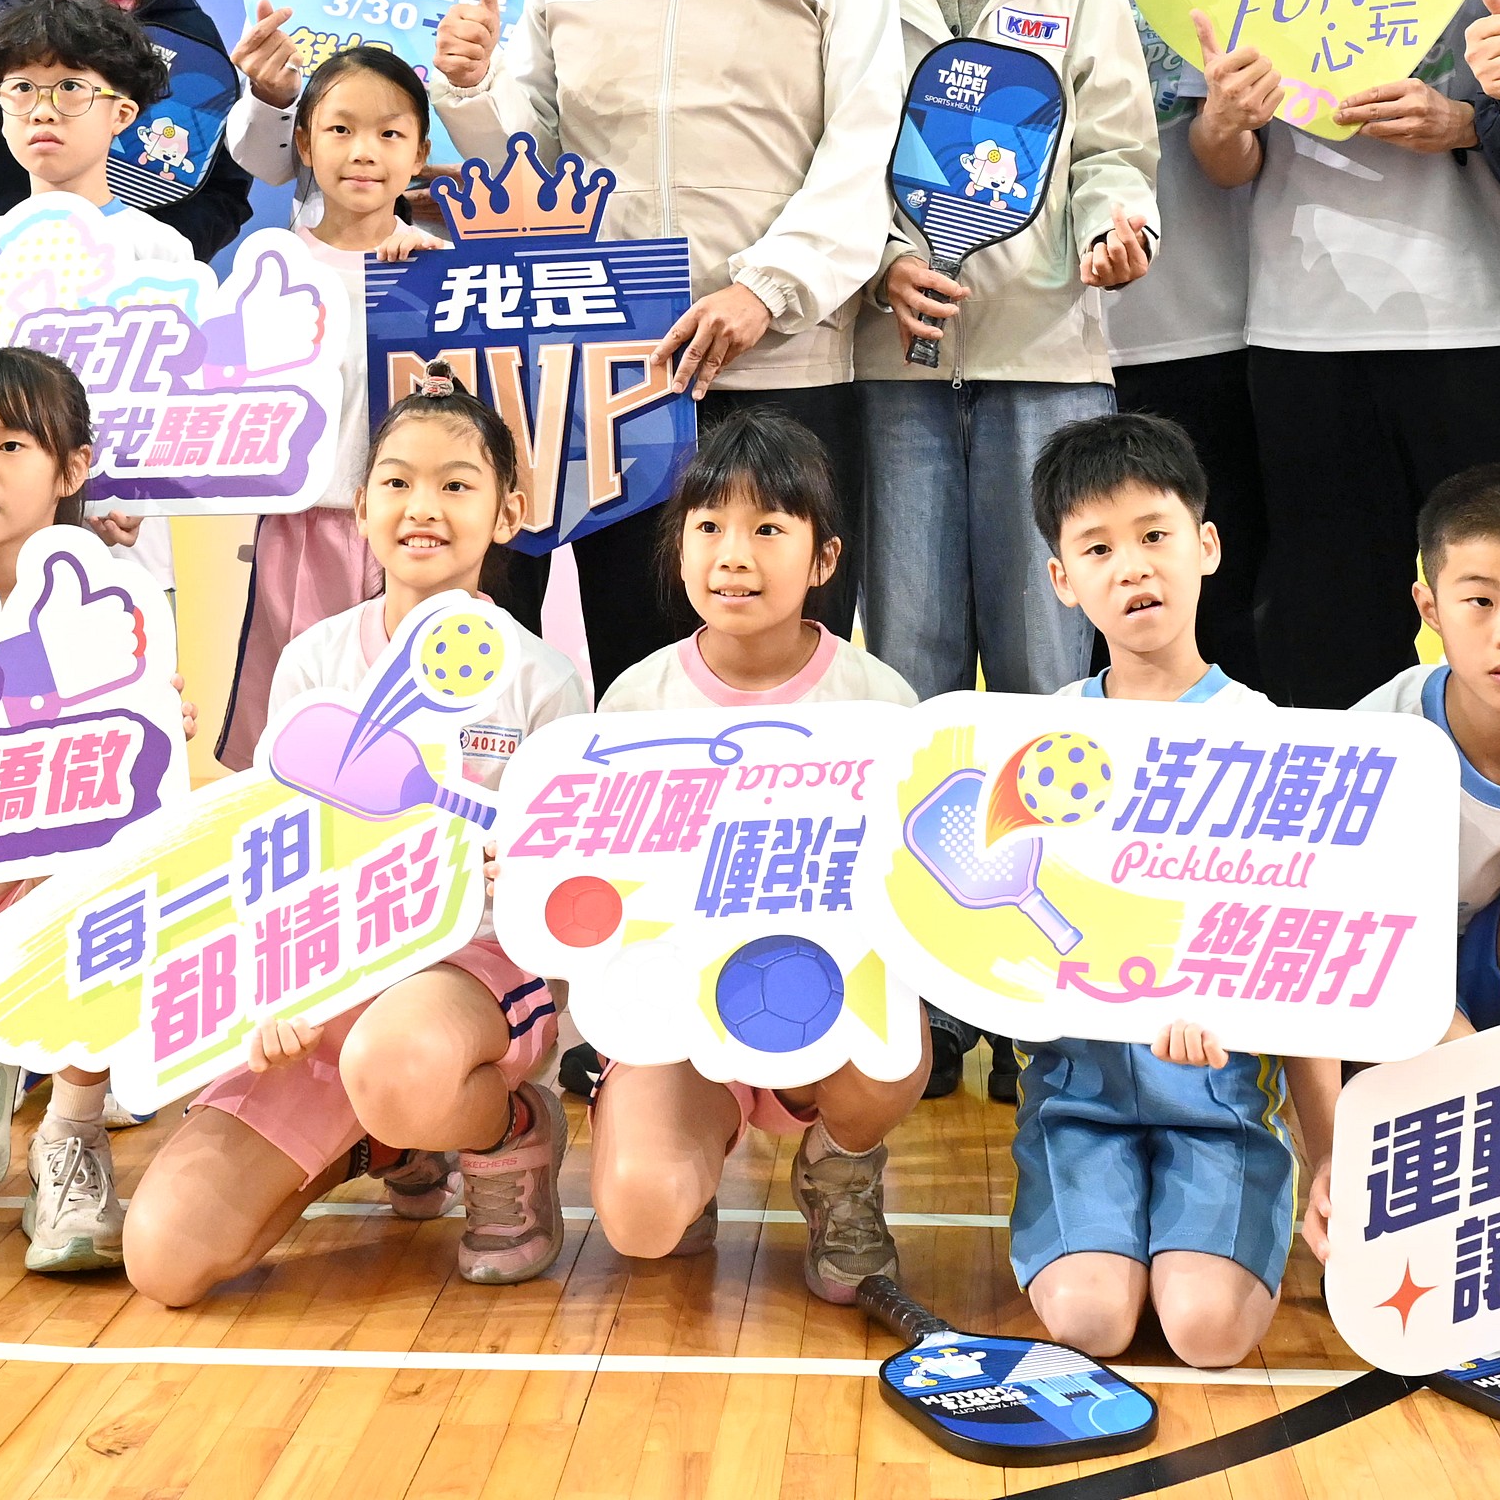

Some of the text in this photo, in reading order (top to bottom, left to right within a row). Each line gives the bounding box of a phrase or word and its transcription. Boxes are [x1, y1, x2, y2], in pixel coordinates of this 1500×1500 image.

[1007, 15, 1061, 40] KMT
[1311, 0, 1419, 75] 心玩
[950, 58, 992, 78] NEW
[938, 69, 988, 93] TAIPEI
[945, 86, 985, 106] CITY
[434, 260, 627, 333] 我是
[471, 736, 516, 754] 40120
[1110, 735, 1399, 848] 活力揮拍
[507, 767, 729, 858] 趣味多
[1110, 839, 1317, 889] Pickleball
[77, 809, 311, 982] 每一拍
[150, 826, 440, 1062] 都精彩
[1176, 901, 1416, 1008] 樂開打
[463, 1157, 518, 1169] SKECHERS
[940, 1390, 1028, 1411] SPORTS
[952, 1407, 975, 1416] CITY
[975, 1401, 1008, 1413] TAIPEI
